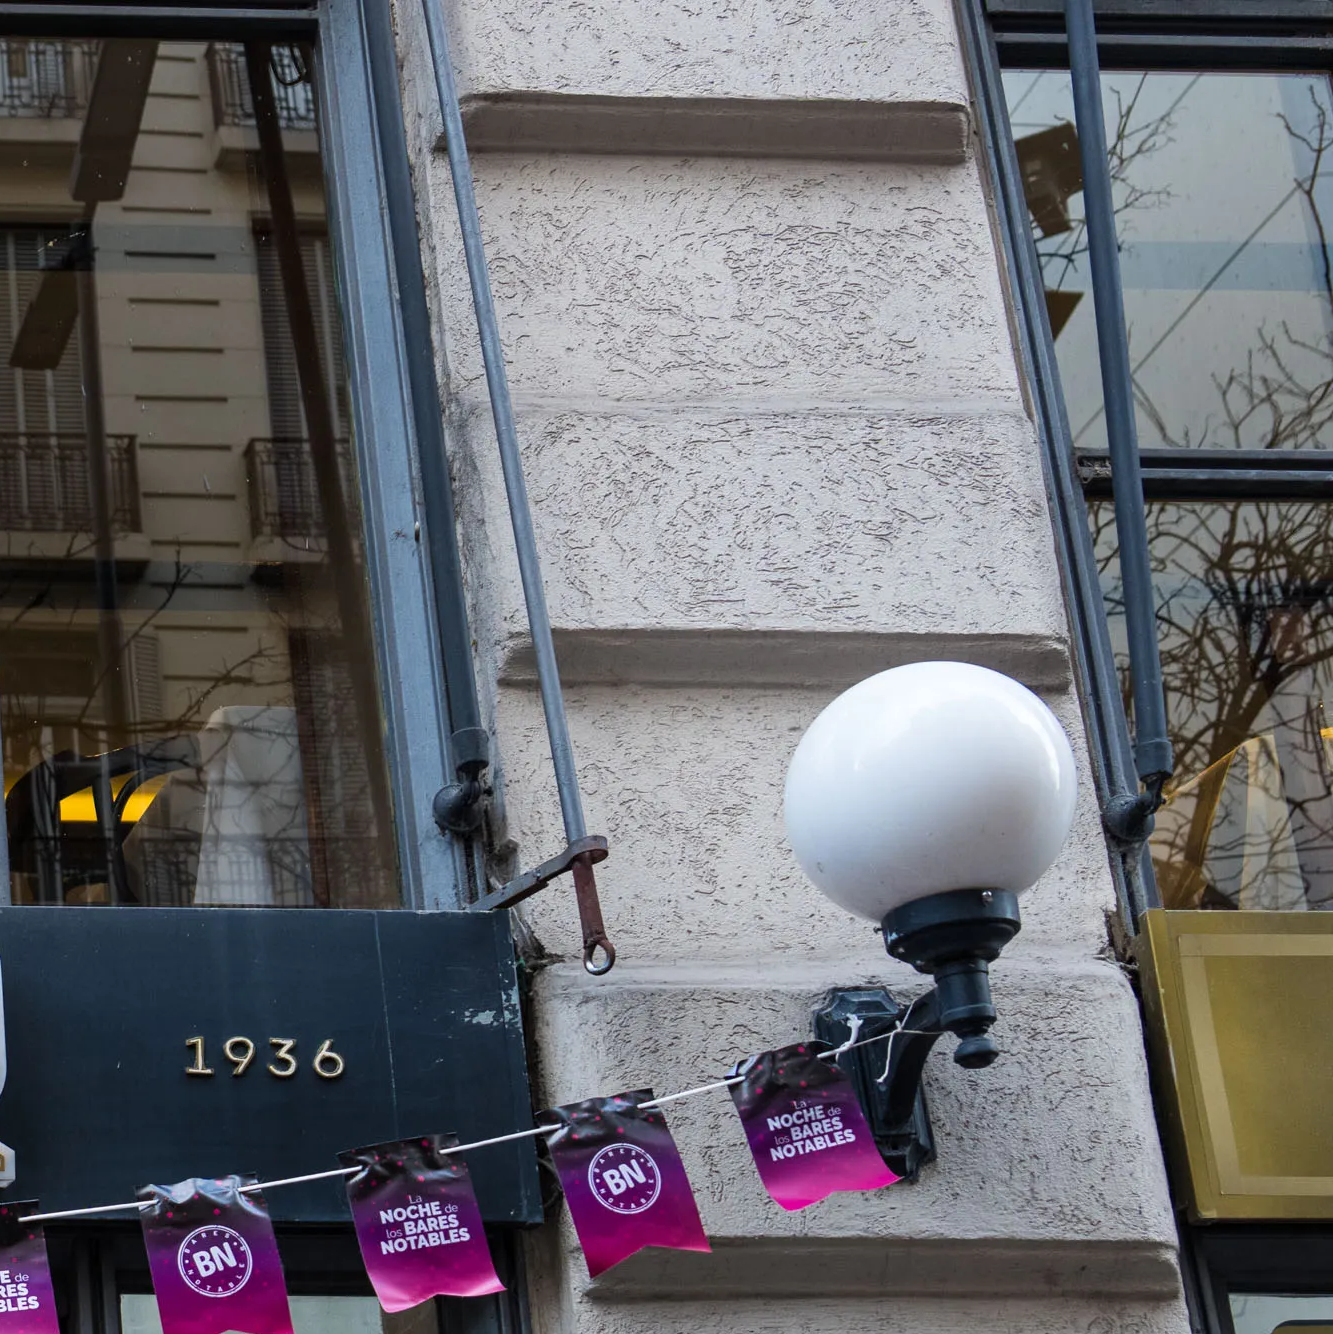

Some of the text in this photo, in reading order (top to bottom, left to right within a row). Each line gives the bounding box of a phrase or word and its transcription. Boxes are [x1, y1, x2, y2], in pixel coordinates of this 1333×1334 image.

[183, 1034, 347, 1080] 1936
[603, 1160, 647, 1195] BN
[379, 1201, 459, 1224] NOCHE de
[408, 1195, 422, 1205] La
[386, 1214, 459, 1238] los BARES
[380, 1227, 471, 1255] NOTABLES
[192, 1243, 236, 1276] BN
